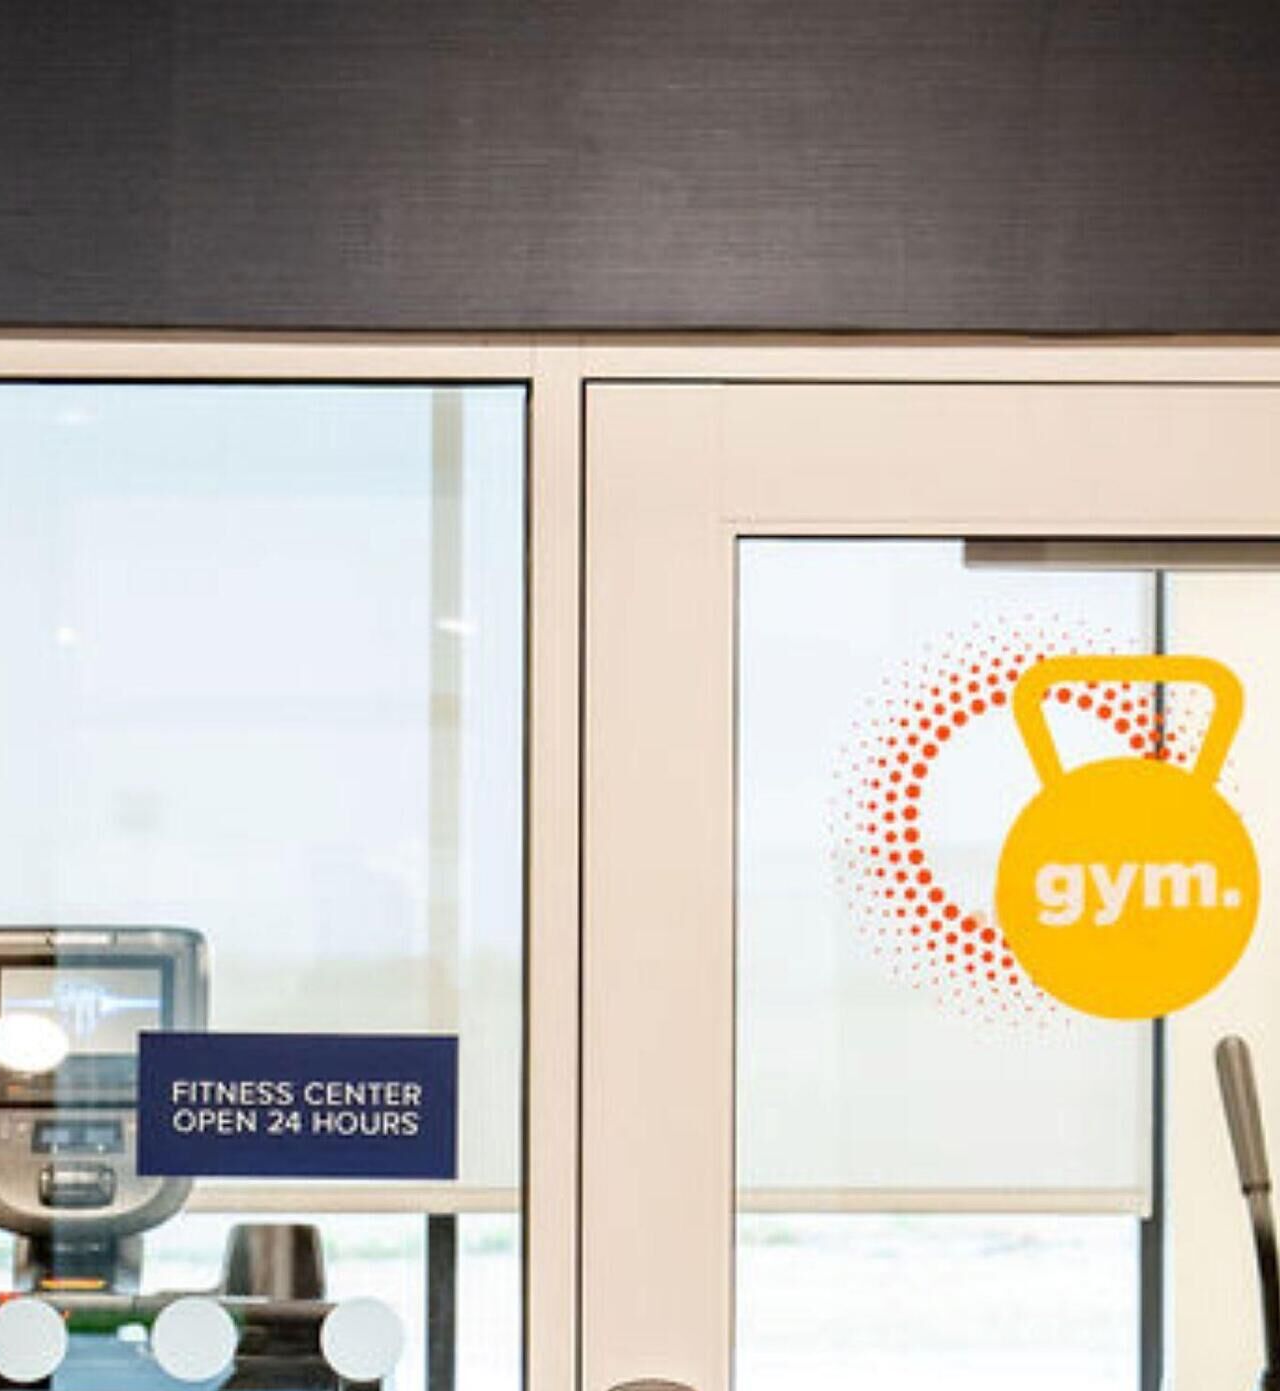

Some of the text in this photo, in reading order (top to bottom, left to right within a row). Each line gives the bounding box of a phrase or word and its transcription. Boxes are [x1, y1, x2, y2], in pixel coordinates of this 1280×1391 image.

[1035, 861, 1241, 927] gym.
[173, 1080, 422, 1106] FITNESS CENTER
[173, 1108, 419, 1136] OPEN 24 HOURS
